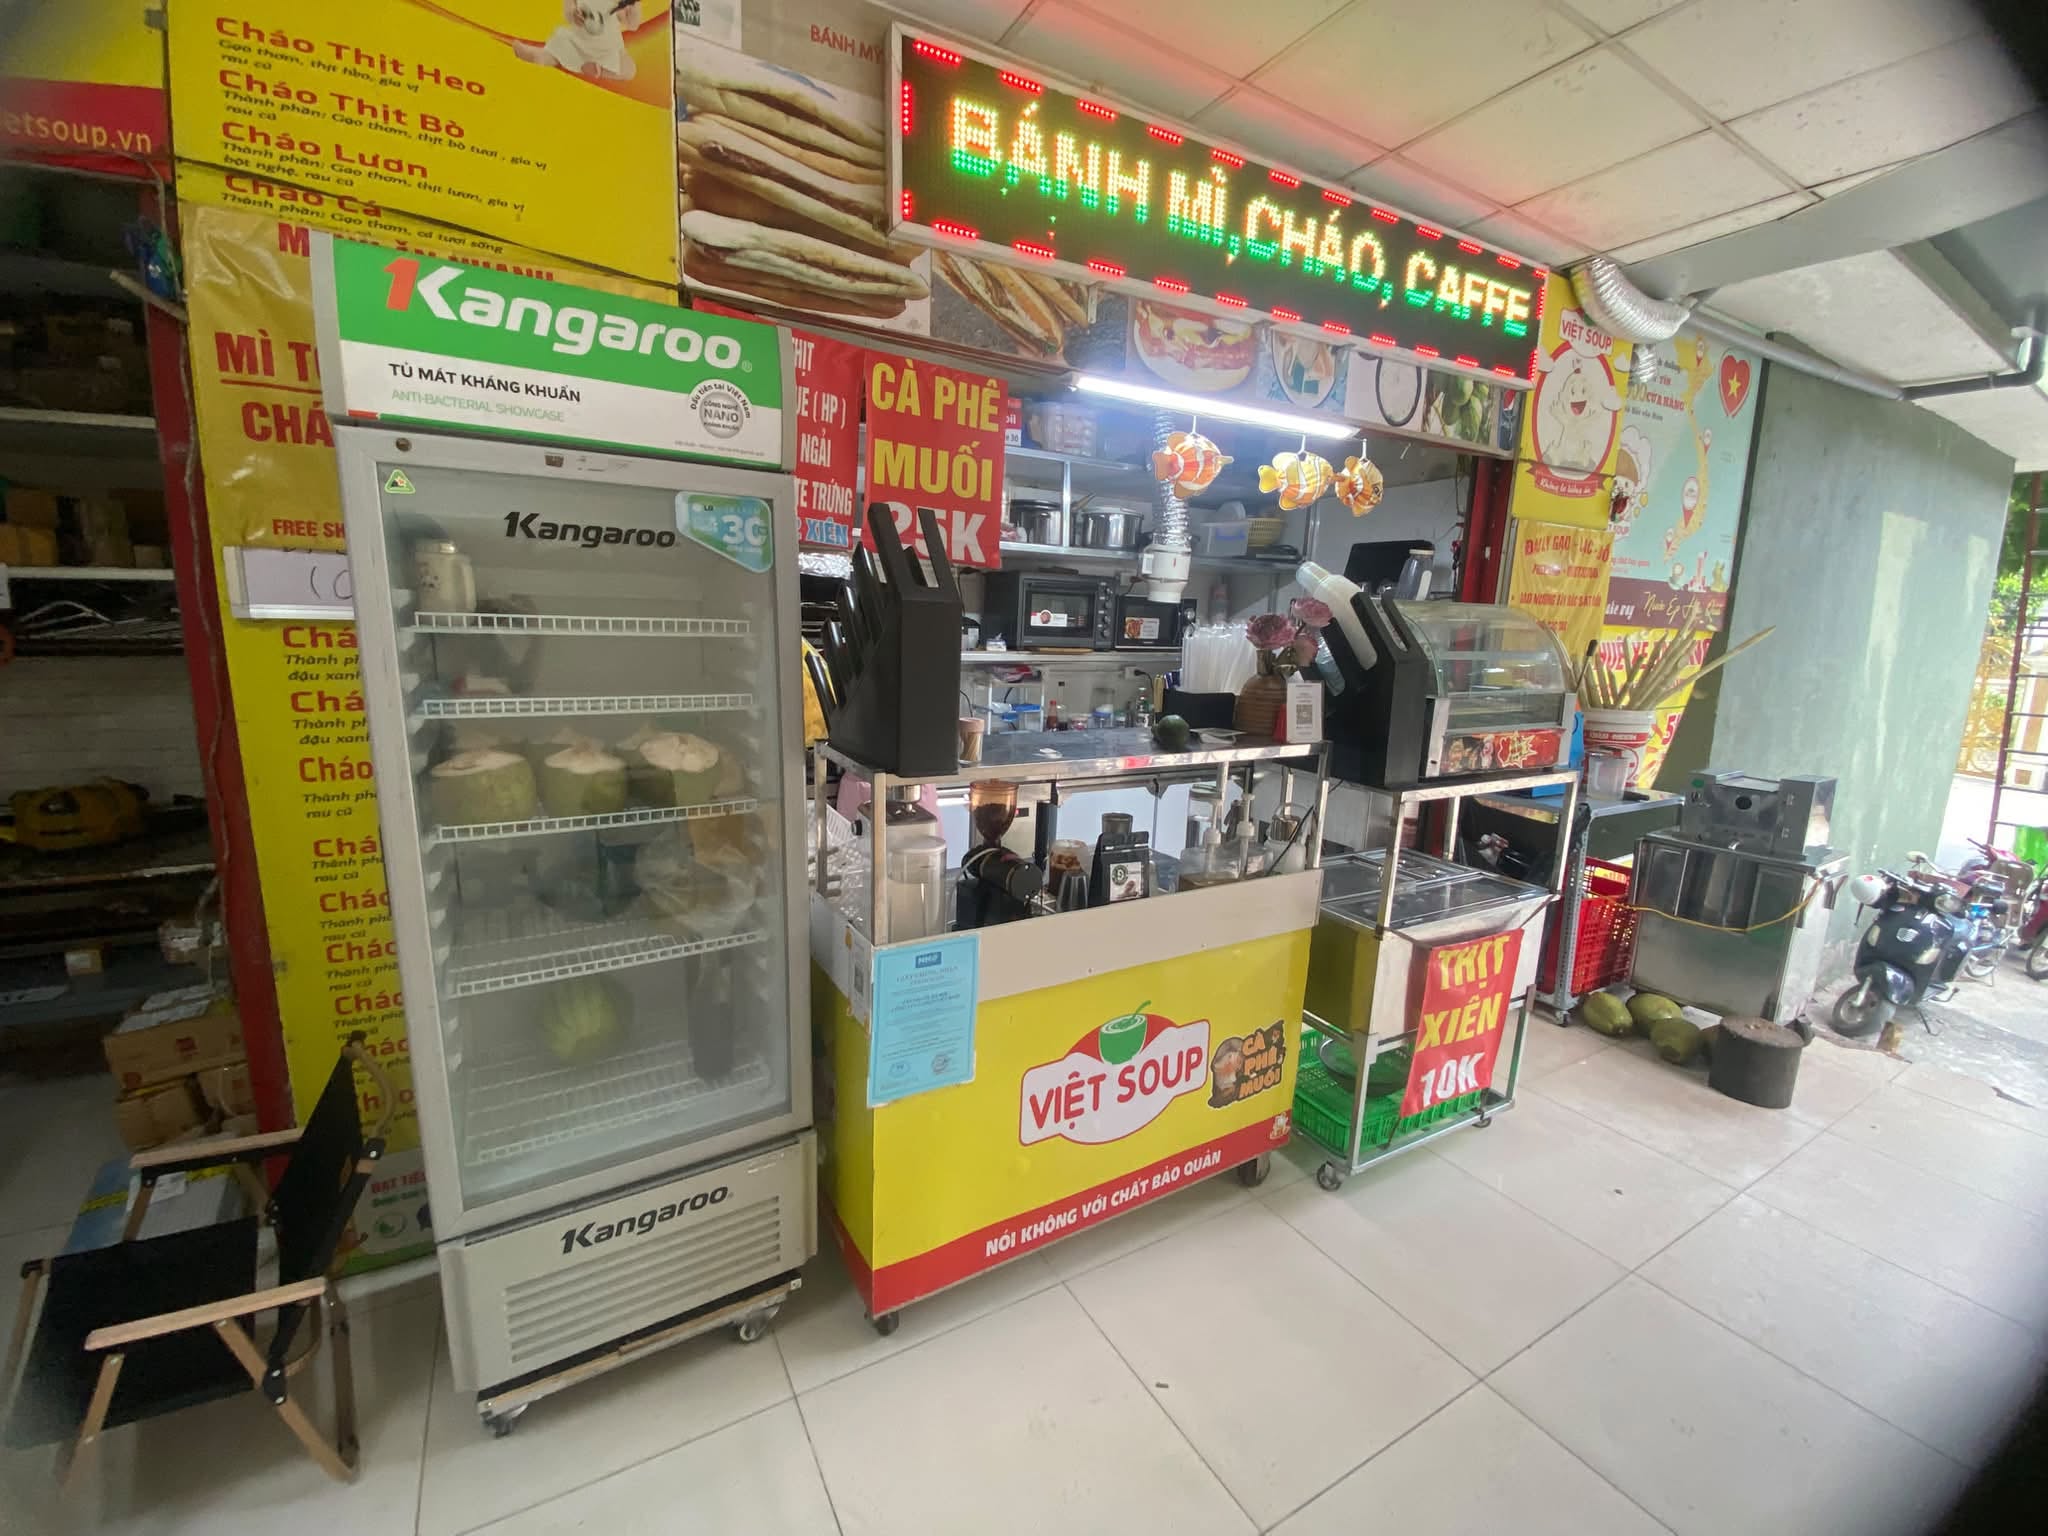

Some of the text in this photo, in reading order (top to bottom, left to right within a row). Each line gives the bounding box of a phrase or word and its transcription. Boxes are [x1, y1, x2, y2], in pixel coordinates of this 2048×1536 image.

[810, 23, 857, 57] BÁNH
[216, 16, 486, 96] Cháo Thịt Heo
[219, 69, 466, 139] Cháo Thịt Bò
[224, 90, 274, 108] Thành
[222, 121, 428, 179] Cháo Lươn
[222, 141, 273, 159] Thành
[949, 97, 1151, 227] BÁNH
[1404, 250, 1532, 338] CAFFE
[214, 328, 275, 377] MÌ
[1585, 329, 1613, 351] SOUP
[388, 360, 582, 403] TỦ MÁT KHÁNG KHUẨN
[872, 357, 922, 417] CÀ
[933, 377, 1001, 433] PHÊ
[241, 400, 336, 448] CHÁ
[496, 402, 566, 423] SHOWCASE
[703, 409, 739, 423] NANO
[873, 439, 993, 502] MUỐI
[271, 518, 318, 537] FREE
[805, 516, 849, 547] XIÊN
[282, 625, 358, 649] Chá
[285, 654, 338, 666] Thành
[288, 670, 320, 682] đậu
[290, 689, 365, 713] Chá
[293, 718, 346, 730] Thành
[299, 734, 331, 746] đậu
[298, 755, 374, 783] Cháo
[303, 791, 351, 804] Thành
[313, 834, 377, 858] Chá
[1437, 935, 1511, 991] THỊT
[1415, 992, 1503, 1053] XIÊN
[1028, 1045, 1203, 1131] VIỆT SOUP
[1421, 1051, 1485, 1108] 10K
[985, 1148, 1222, 1258] NÓI KHÔNG VỚI CHẤT BẢO QUẢN
